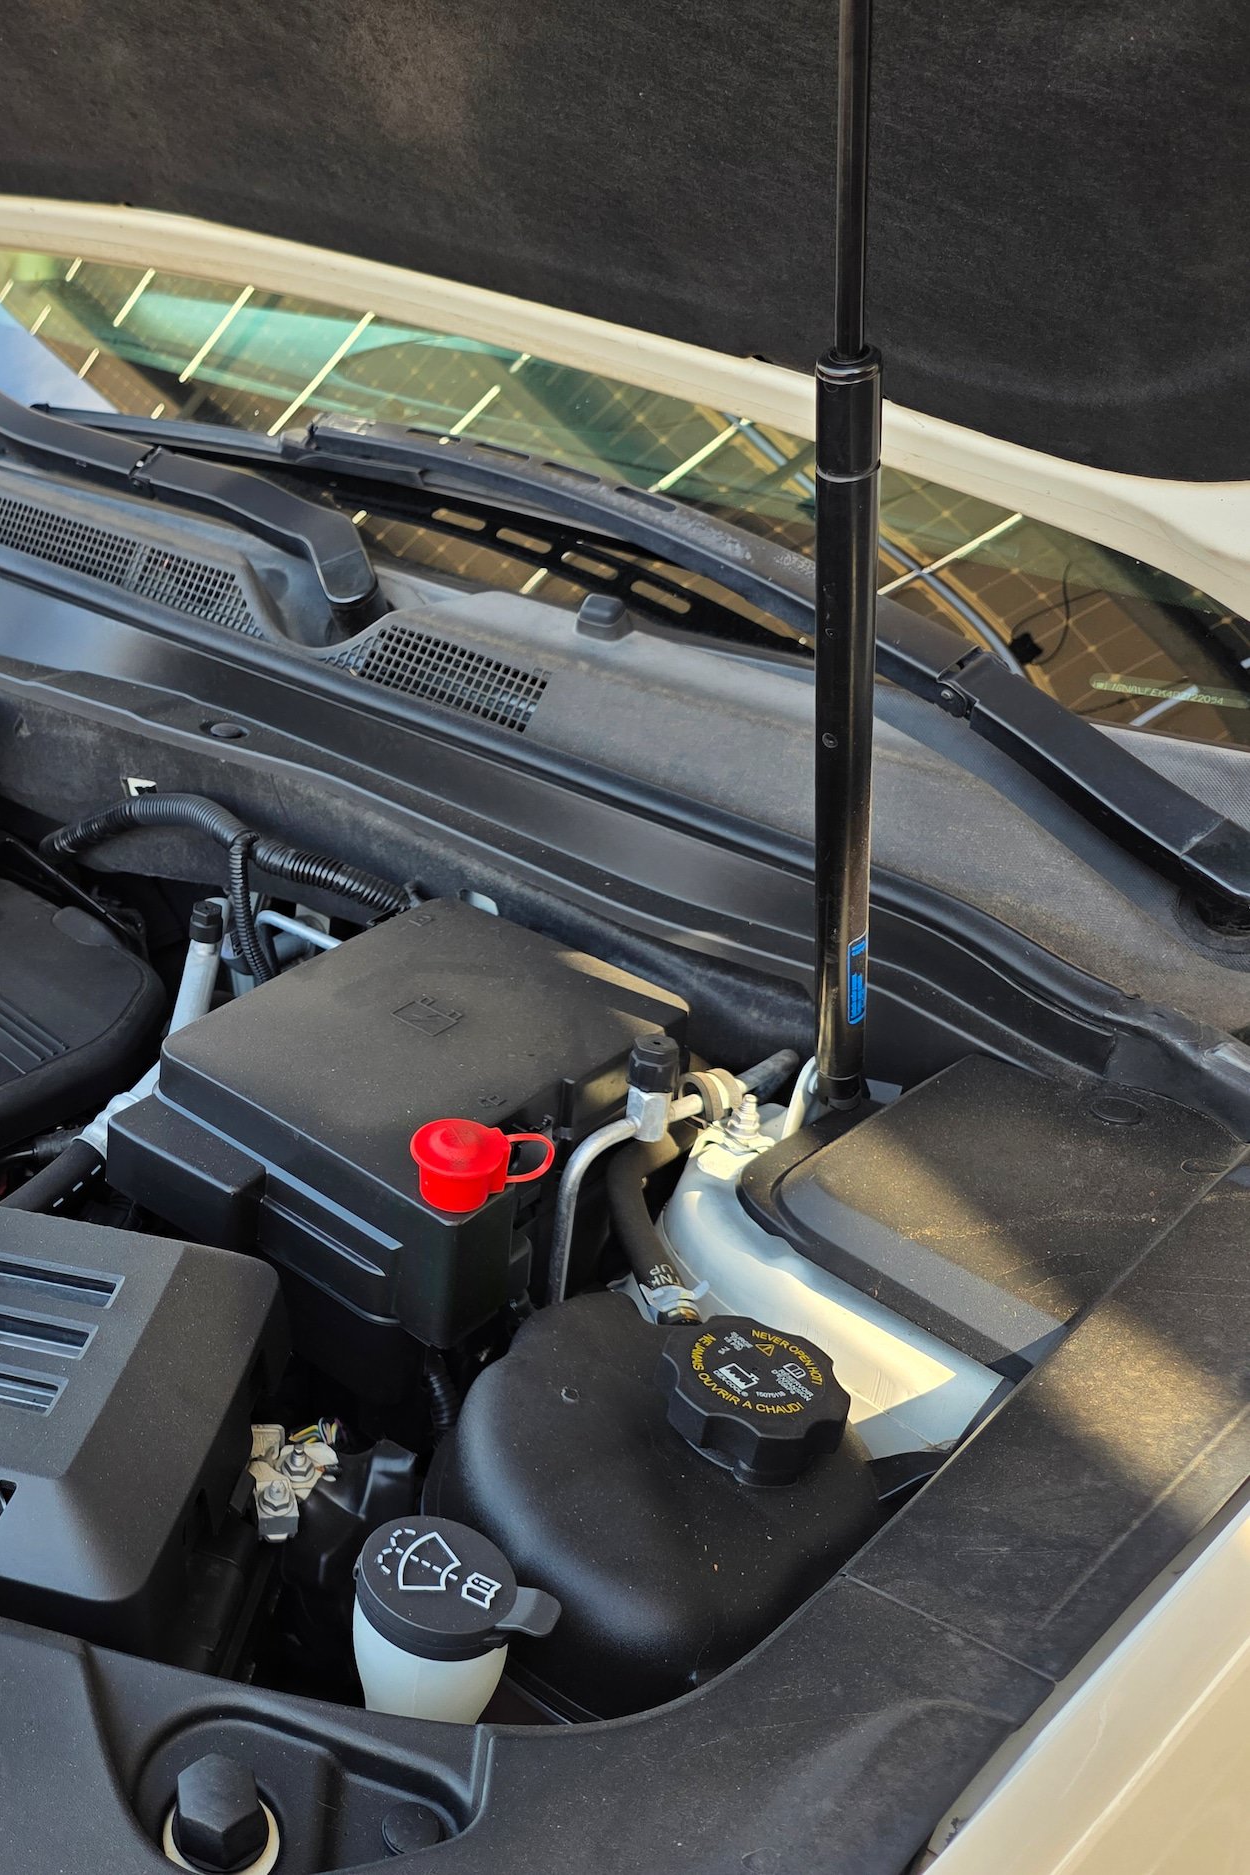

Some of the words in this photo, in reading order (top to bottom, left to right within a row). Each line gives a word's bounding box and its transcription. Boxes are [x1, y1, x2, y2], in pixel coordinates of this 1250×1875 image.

[649, 1263, 674, 1276] UP
[698, 1333, 716, 1346] NE
[752, 1329, 790, 1349] NEVER
[788, 1345, 814, 1366] OPEN
[691, 1342, 706, 1370] JAMAIS
[698, 1372, 740, 1405] OUVRIR
